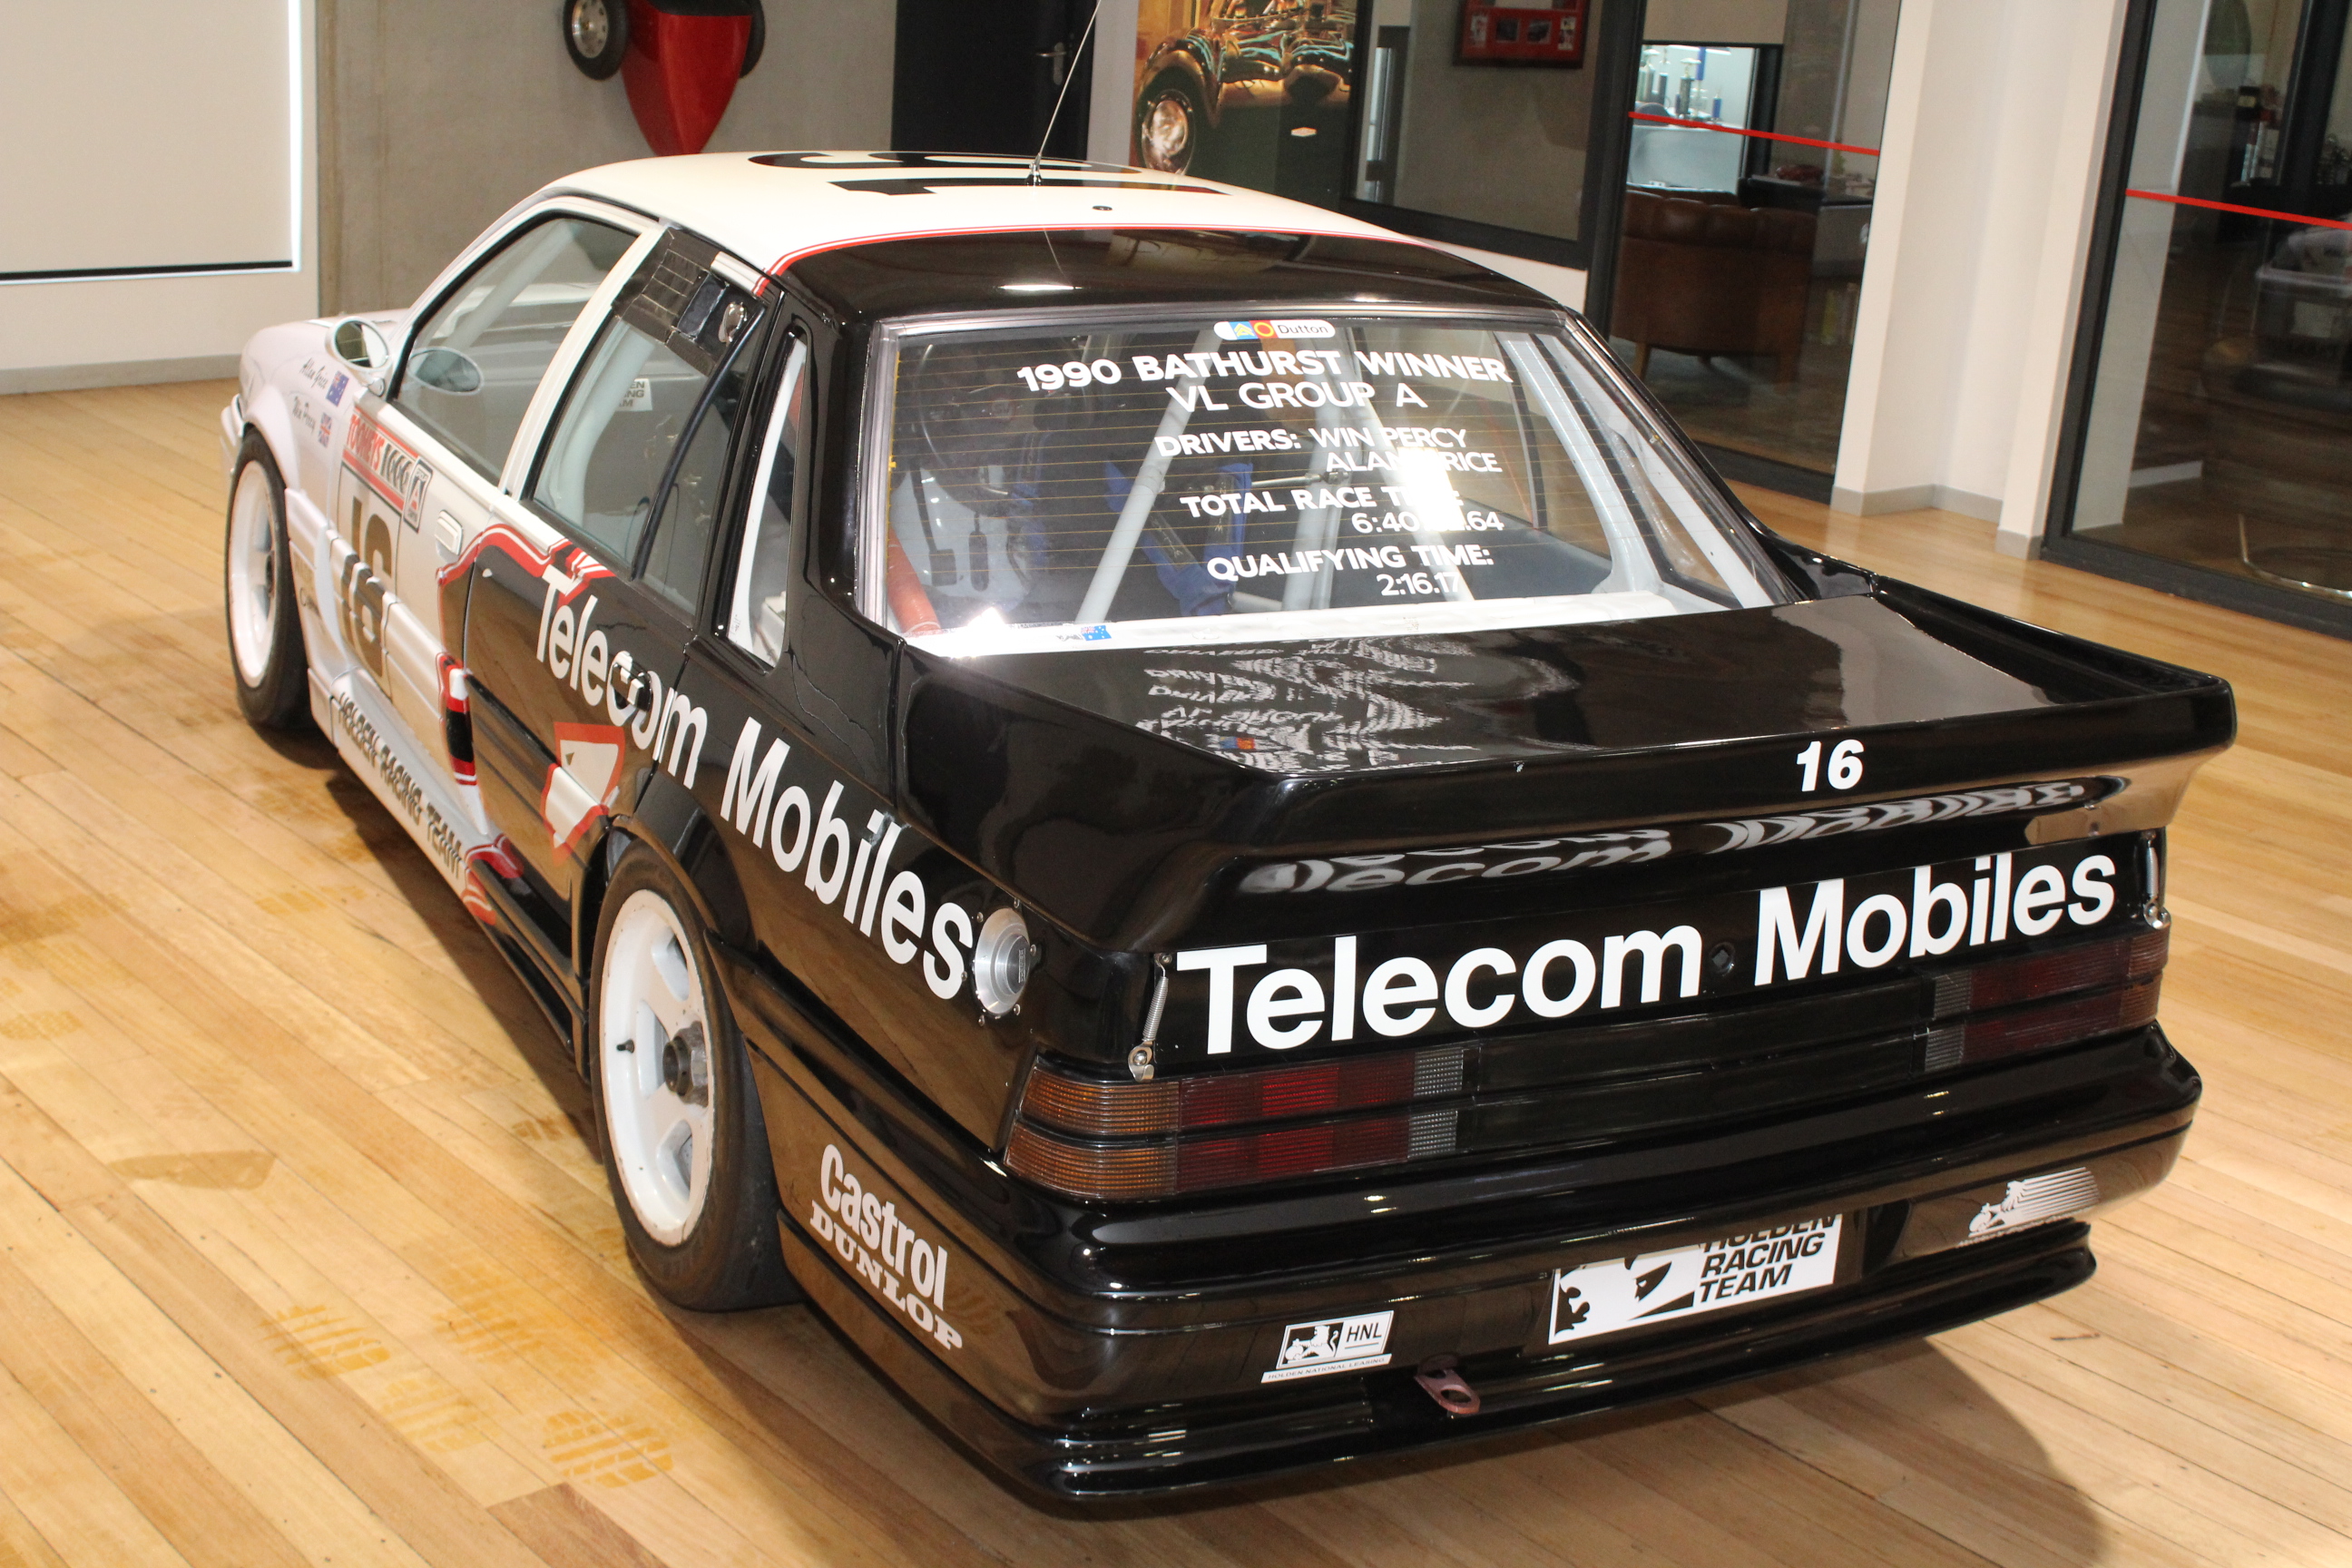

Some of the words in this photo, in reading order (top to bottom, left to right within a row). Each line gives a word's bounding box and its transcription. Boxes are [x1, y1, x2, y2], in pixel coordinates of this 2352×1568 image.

[1278, 324, 1328, 335] Dutton
[1017, 357, 1122, 392] 1990
[1132, 349, 1341, 384] BATHURST
[1353, 350, 1514, 384] WINNER
[1165, 383, 1229, 413] VL
[1239, 380, 1376, 409] GROUP
[1396, 383, 1428, 408] A
[1154, 427, 1301, 457] DRIVERS:
[1308, 426, 1376, 448] WIN
[1378, 426, 1466, 448] PERCY
[1423, 451, 1503, 473] RICE
[1180, 491, 1287, 517] TOTAL
[1290, 486, 1377, 510] RACE
[1207, 545, 1406, 582] QUALIFYING
[1410, 544, 1494, 566] TIME:
[1376, 572, 1462, 596] 2:16.17
[535, 563, 708, 789] Telecom
[720, 716, 974, 999] Mobiles
[1795, 740, 1865, 794] 16
[1176, 921, 1703, 1056] Telecom
[1753, 851, 2116, 987] Mobiles
[820, 1143, 947, 1311] Castrol
[1700, 1231, 1826, 1278] RACING
[809, 1199, 963, 1350] DUNLOP
[1700, 1263, 1793, 1302] TEAM
[1346, 1322, 1382, 1343] HNL
[1269, 1370, 1303, 1379] HOLDEN
[1305, 1364, 1346, 1375] NATIONAL
